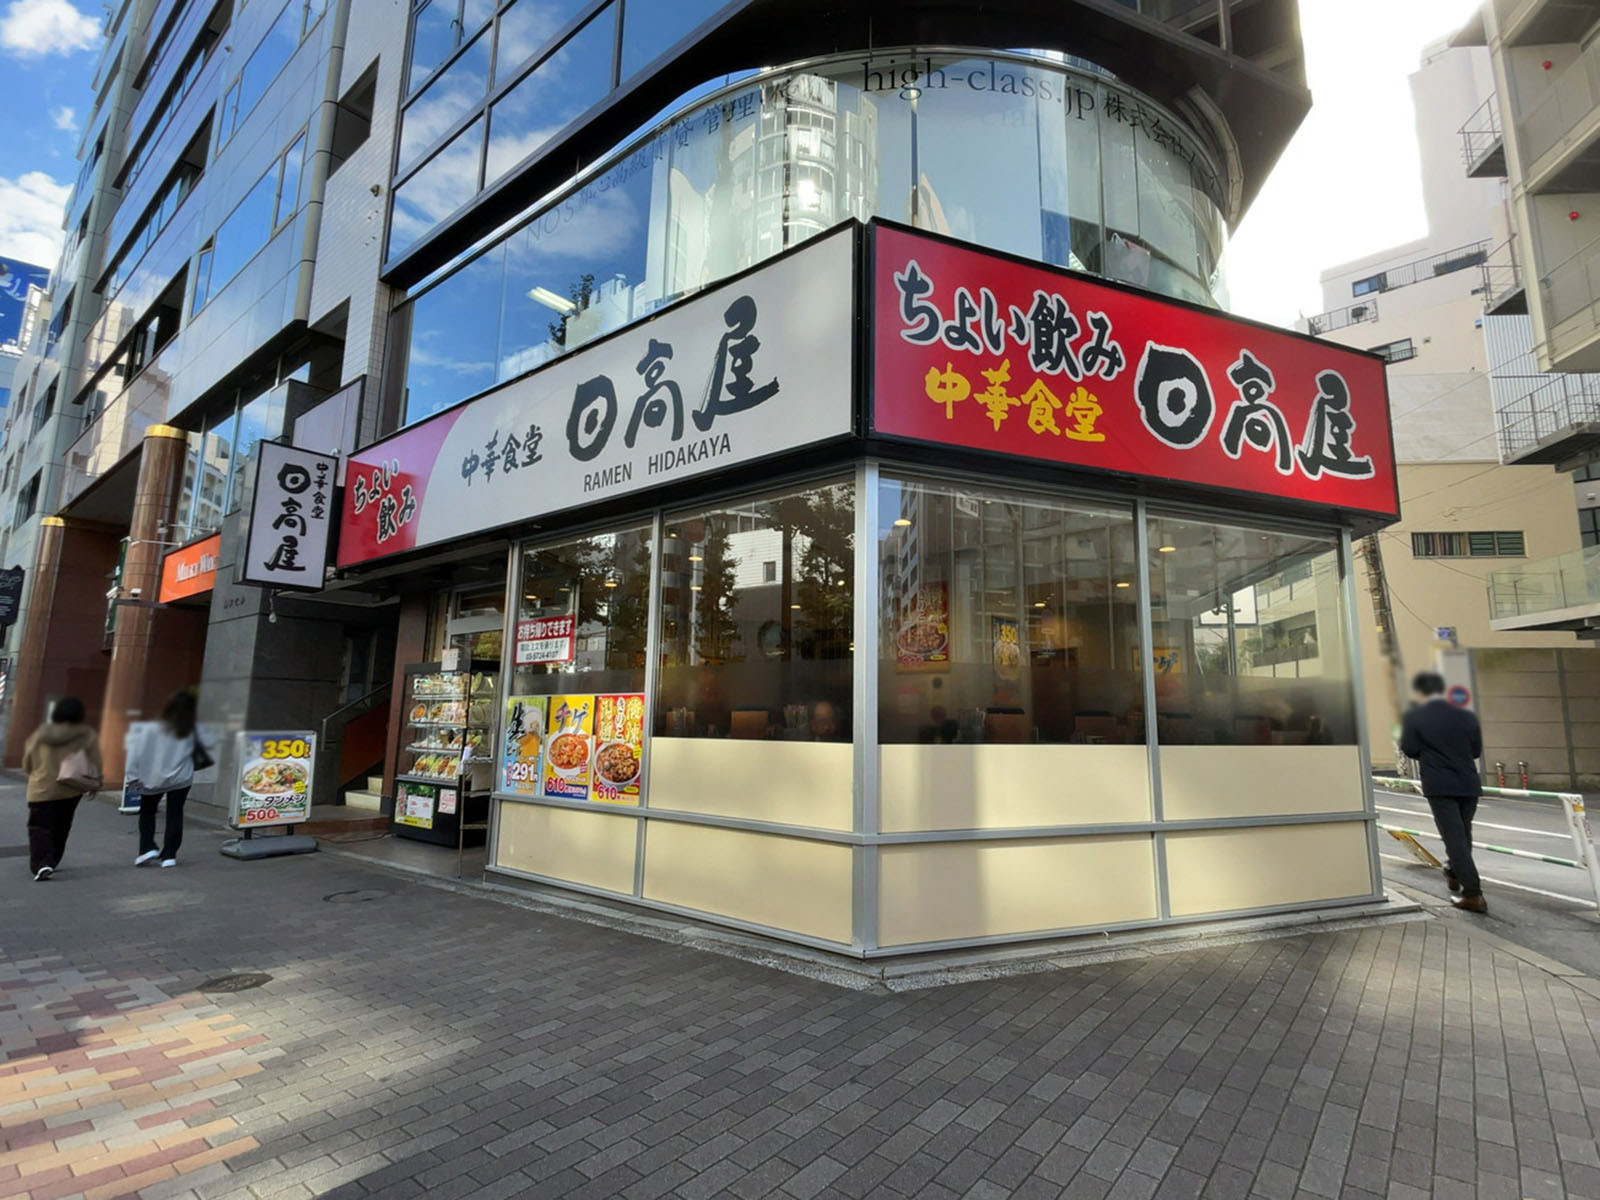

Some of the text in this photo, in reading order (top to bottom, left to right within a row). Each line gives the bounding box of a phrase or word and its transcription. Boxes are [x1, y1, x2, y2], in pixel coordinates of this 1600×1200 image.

[862, 57, 1096, 121] high-class.jp
[894, 259, 1126, 382] ちょい飲み
[924, 360, 1106, 442] 中華食堂
[461, 424, 543, 487] 中華食堂
[583, 433, 732, 493] RAMEN HIDAKAYA
[311, 461, 329, 520] 中華食堂
[354, 458, 400, 514] ちょい
[377, 484, 417, 544] 飲み
[554, 702, 589, 735] チゲ
